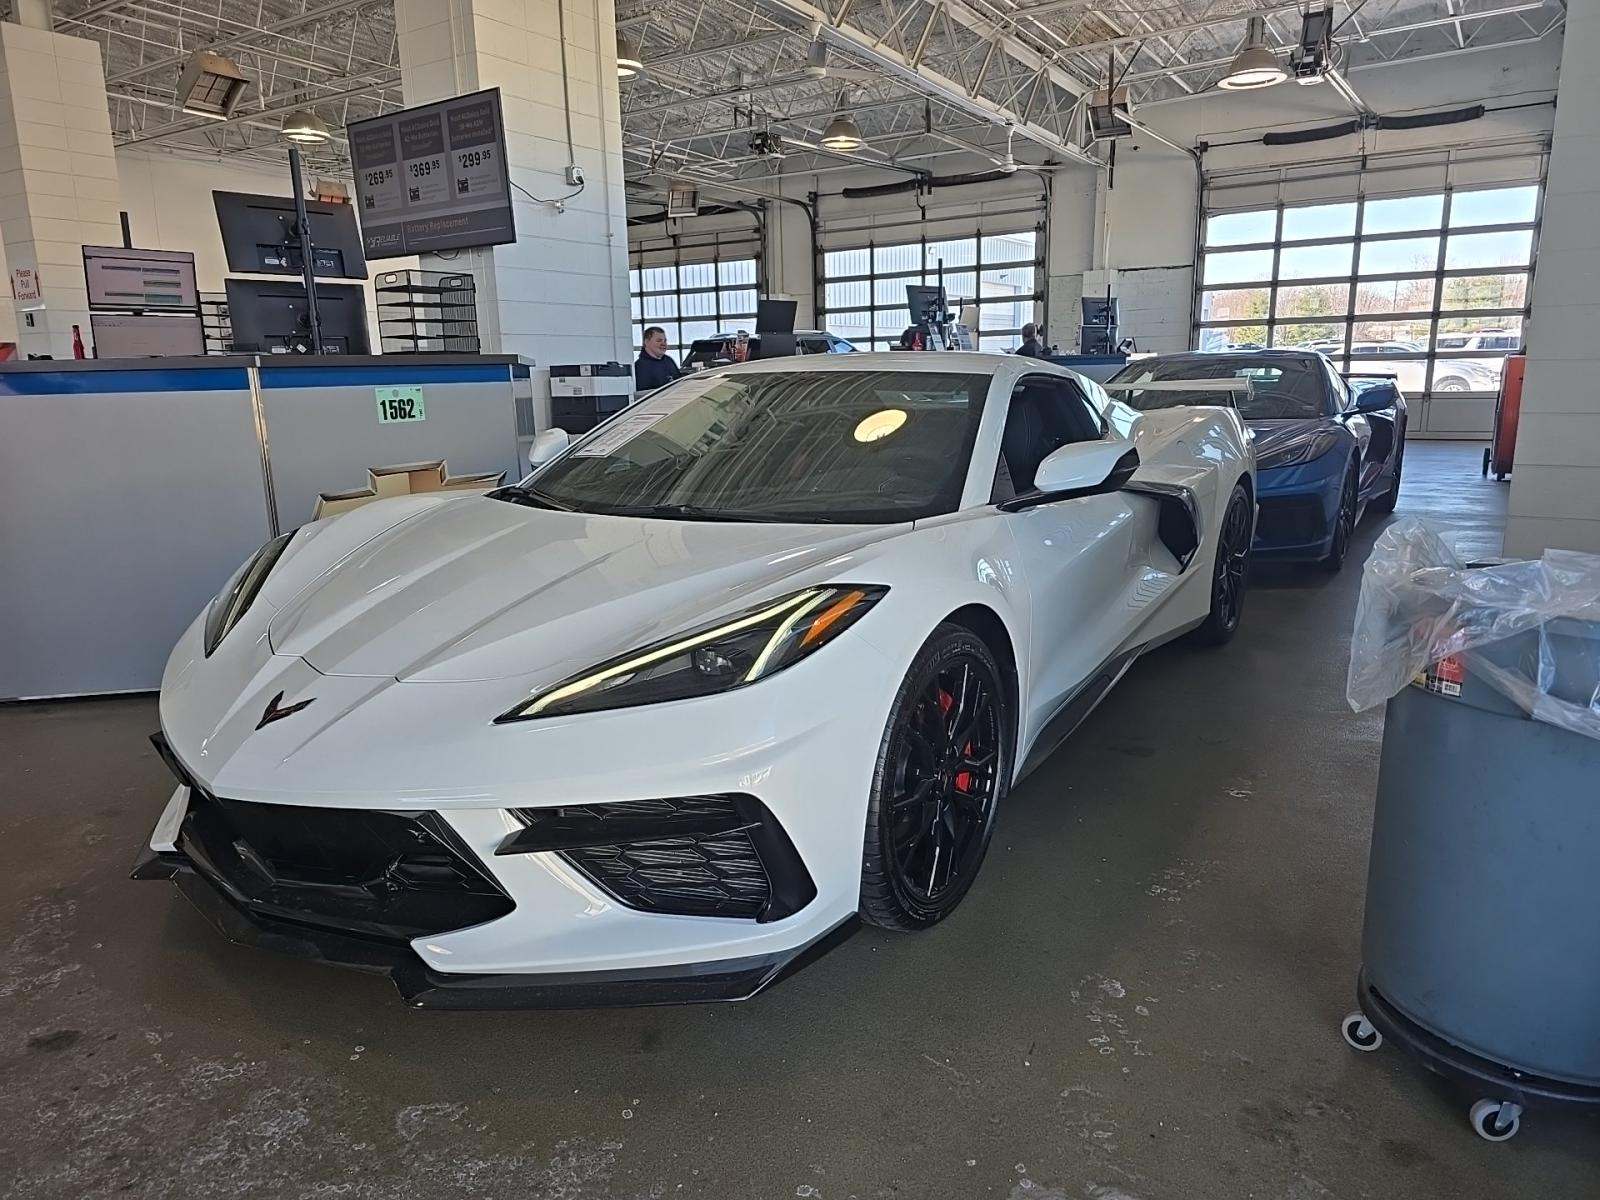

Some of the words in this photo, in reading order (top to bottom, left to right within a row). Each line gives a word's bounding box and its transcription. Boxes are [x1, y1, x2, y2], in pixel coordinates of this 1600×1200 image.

[458, 150, 491, 168] $299.95
[410, 160, 440, 178] $369.95
[408, 223, 429, 233] Battery
[16, 270, 31, 278] Please
[20, 280, 30, 288] Pull
[18, 290, 36, 300] Forward
[380, 398, 416, 420] 1562
